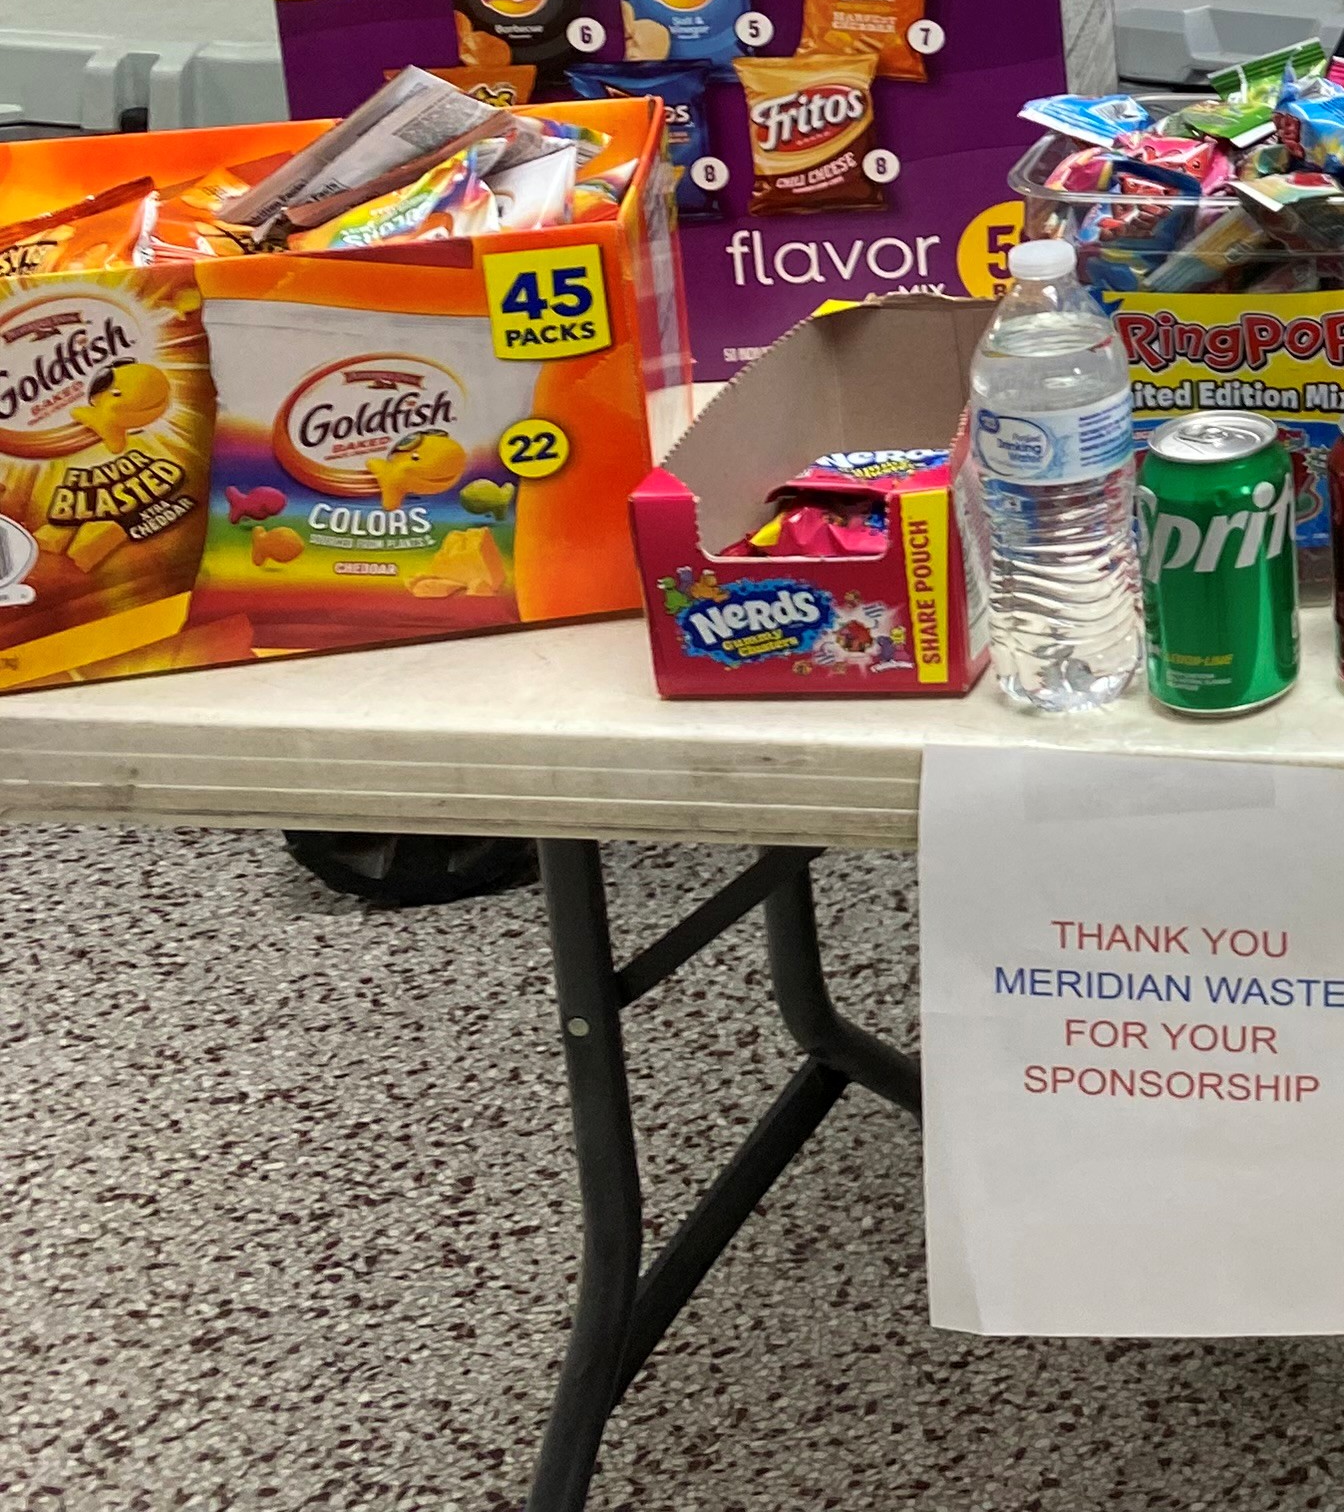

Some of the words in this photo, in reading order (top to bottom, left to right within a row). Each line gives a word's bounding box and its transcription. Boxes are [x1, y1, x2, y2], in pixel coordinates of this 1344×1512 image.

[752, 90, 865, 150] Fritos
[726, 230, 940, 286] flavor
[500, 267, 593, 318] 45
[504, 322, 596, 347] PACKS
[1200, 380, 1299, 410] Edition
[300, 391, 451, 448] Goldfish
[508, 431, 559, 464] 22
[65, 450, 149, 487] FLAVOR
[51, 459, 184, 521] BLASTED
[129, 496, 195, 540] CHEDDAR
[309, 502, 432, 537] COLORS
[335, 563, 397, 576] CHEDDAR
[908, 518, 935, 594] POUCH
[921, 598, 942, 664] SHARE
[1051, 919, 1190, 955] THANK
[1202, 926, 1288, 959] YOU
[994, 967, 1191, 1002] MERIDIAN
[1064, 1018, 1148, 1050] FOR
[1160, 1022, 1278, 1054] YOUR
[1023, 1065, 1321, 1103] SPONSORSHIP
